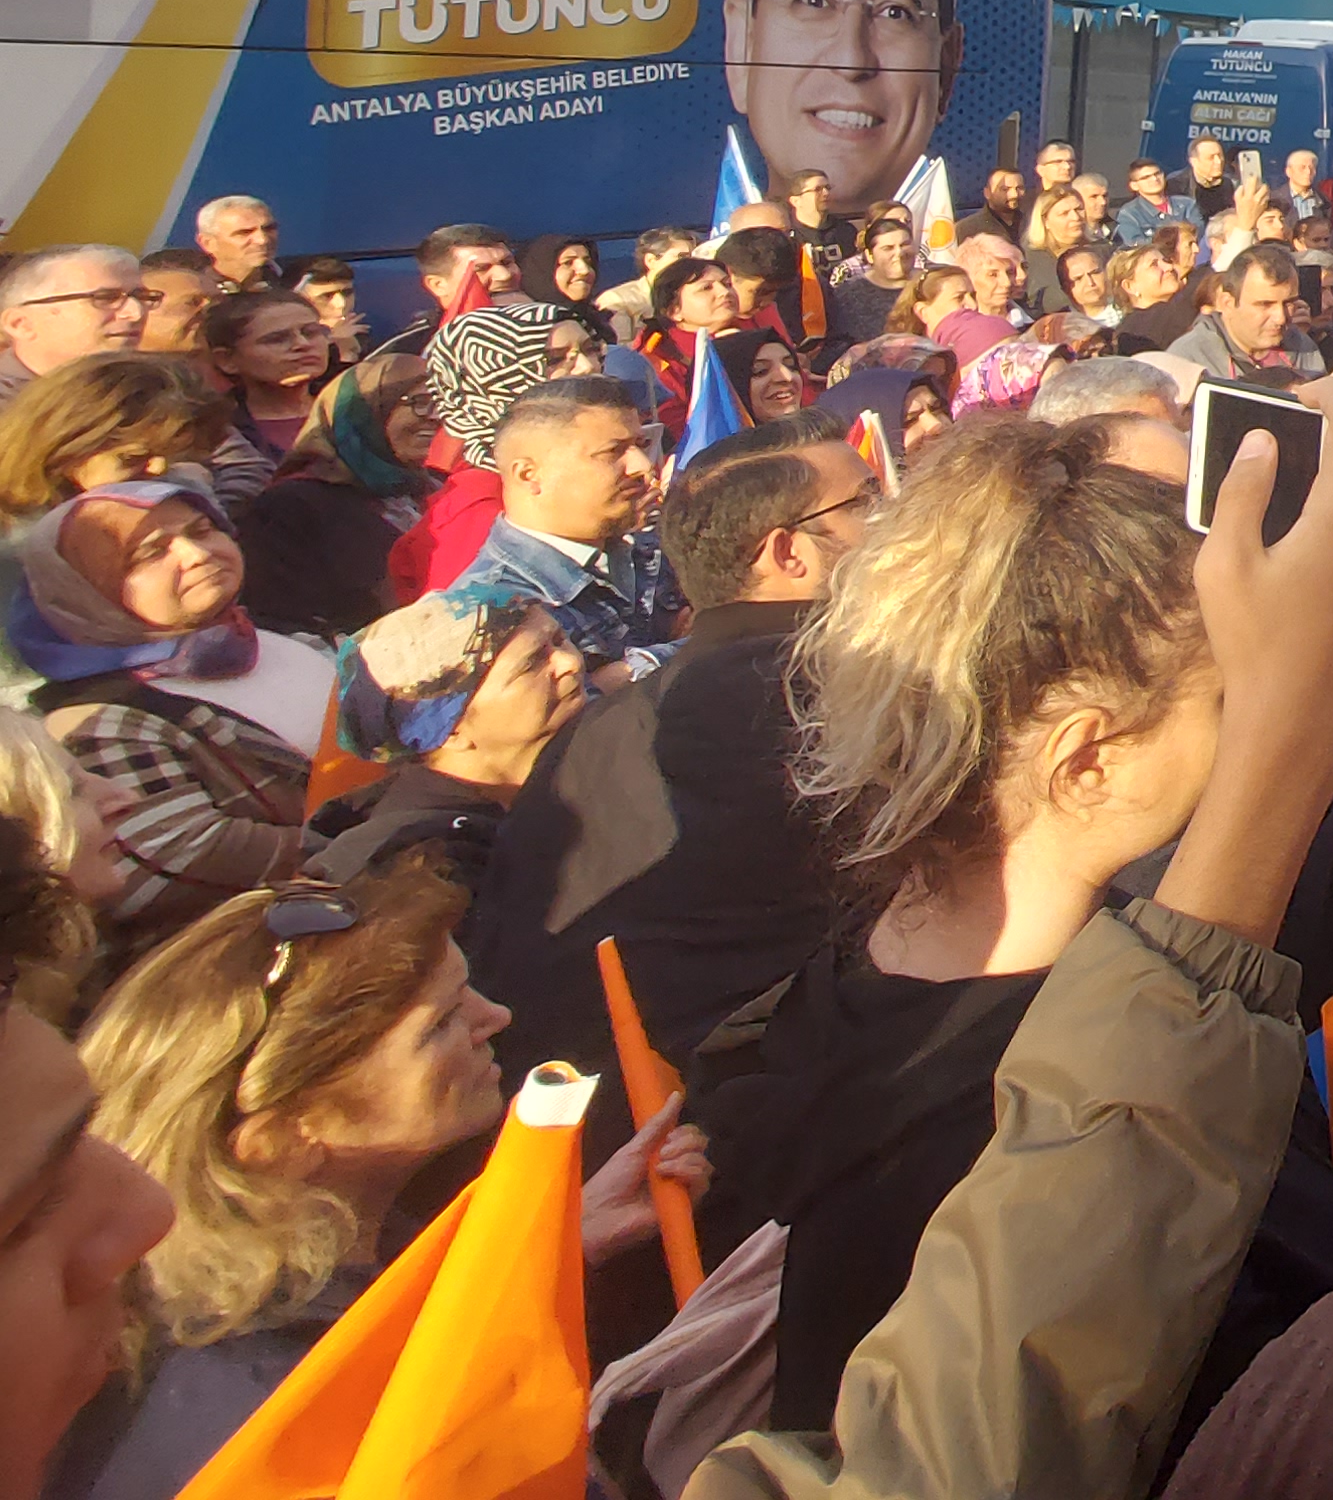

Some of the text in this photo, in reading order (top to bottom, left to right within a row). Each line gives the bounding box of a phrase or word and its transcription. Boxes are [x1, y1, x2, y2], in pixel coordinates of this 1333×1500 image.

[1223, 49, 1264, 60] HAKAN
[310, 94, 432, 126] ANTALYA
[437, 70, 587, 109] BÜYÜKŞEHİR
[1192, 89, 1279, 105] ANTALYA'NIN
[433, 94, 604, 137] BAŞKAN ADAYI
